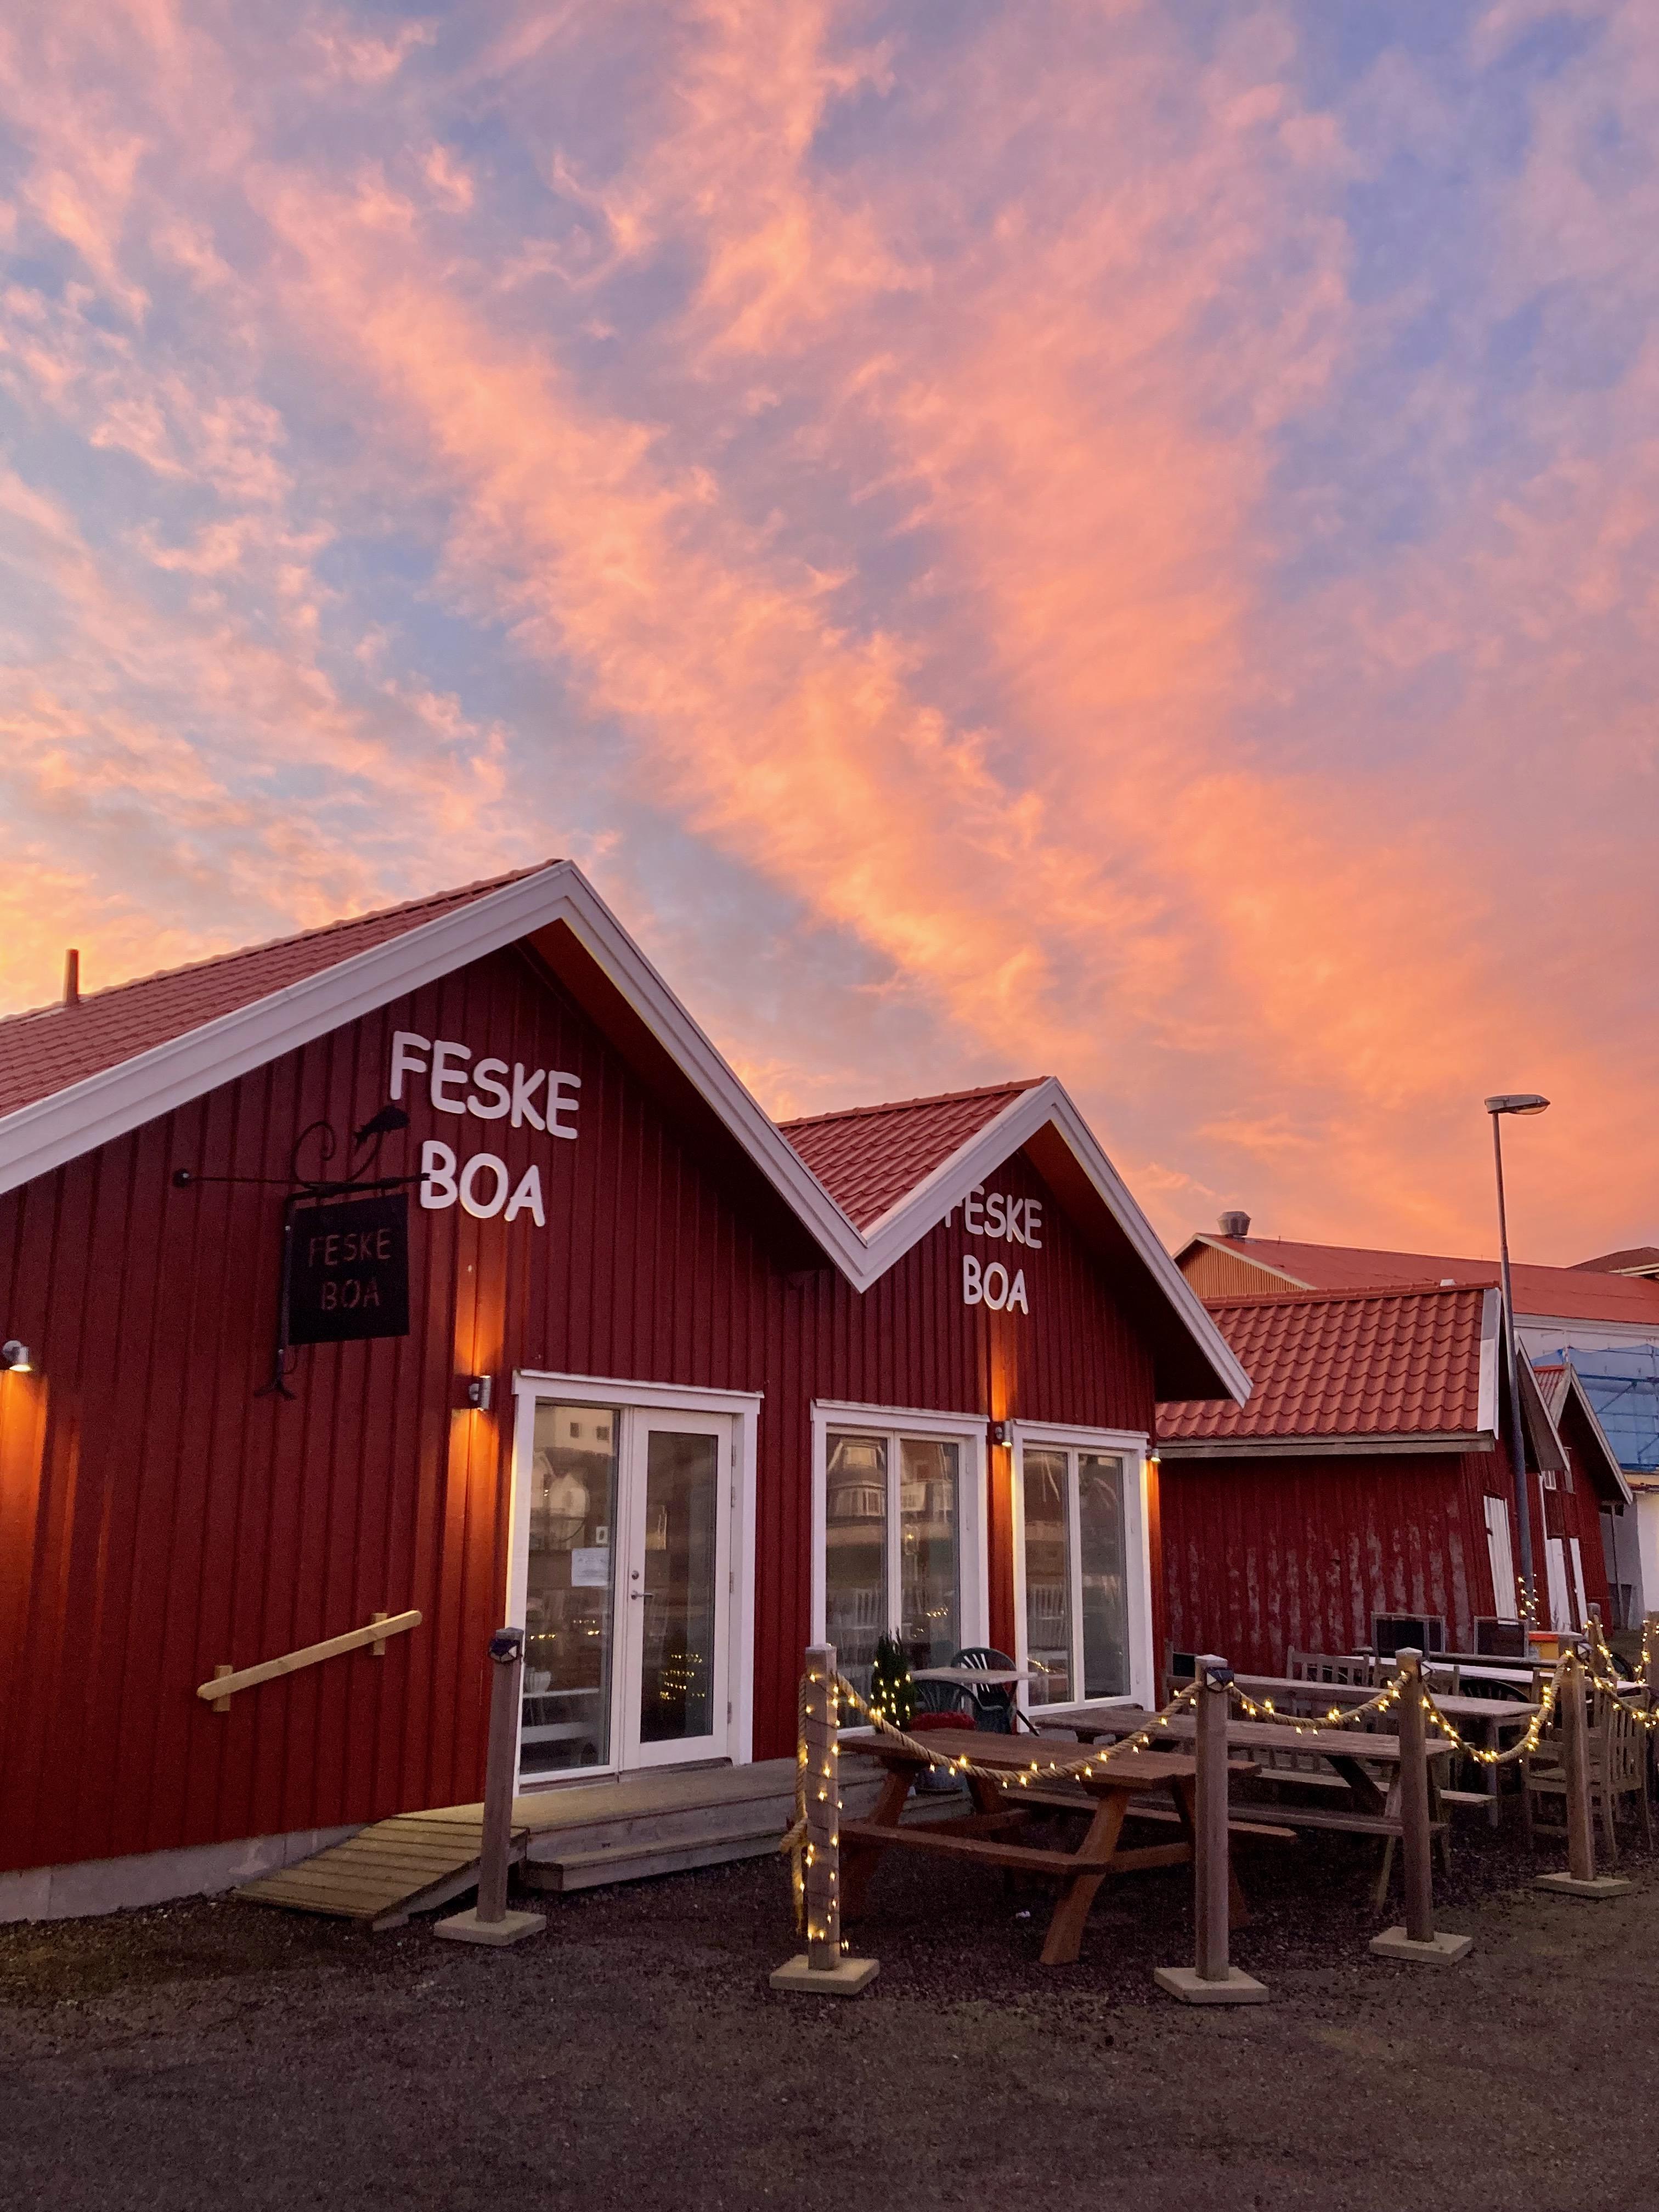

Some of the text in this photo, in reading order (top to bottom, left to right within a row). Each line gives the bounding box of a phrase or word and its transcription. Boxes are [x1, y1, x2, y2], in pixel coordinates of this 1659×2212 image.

[390, 1030, 582, 1139] FESKE
[420, 1140, 545, 1227] BOA
[308, 1227, 391, 1268] FESKE
[321, 1277, 380, 1311] BOA
[963, 1254, 1029, 1315] BOA
